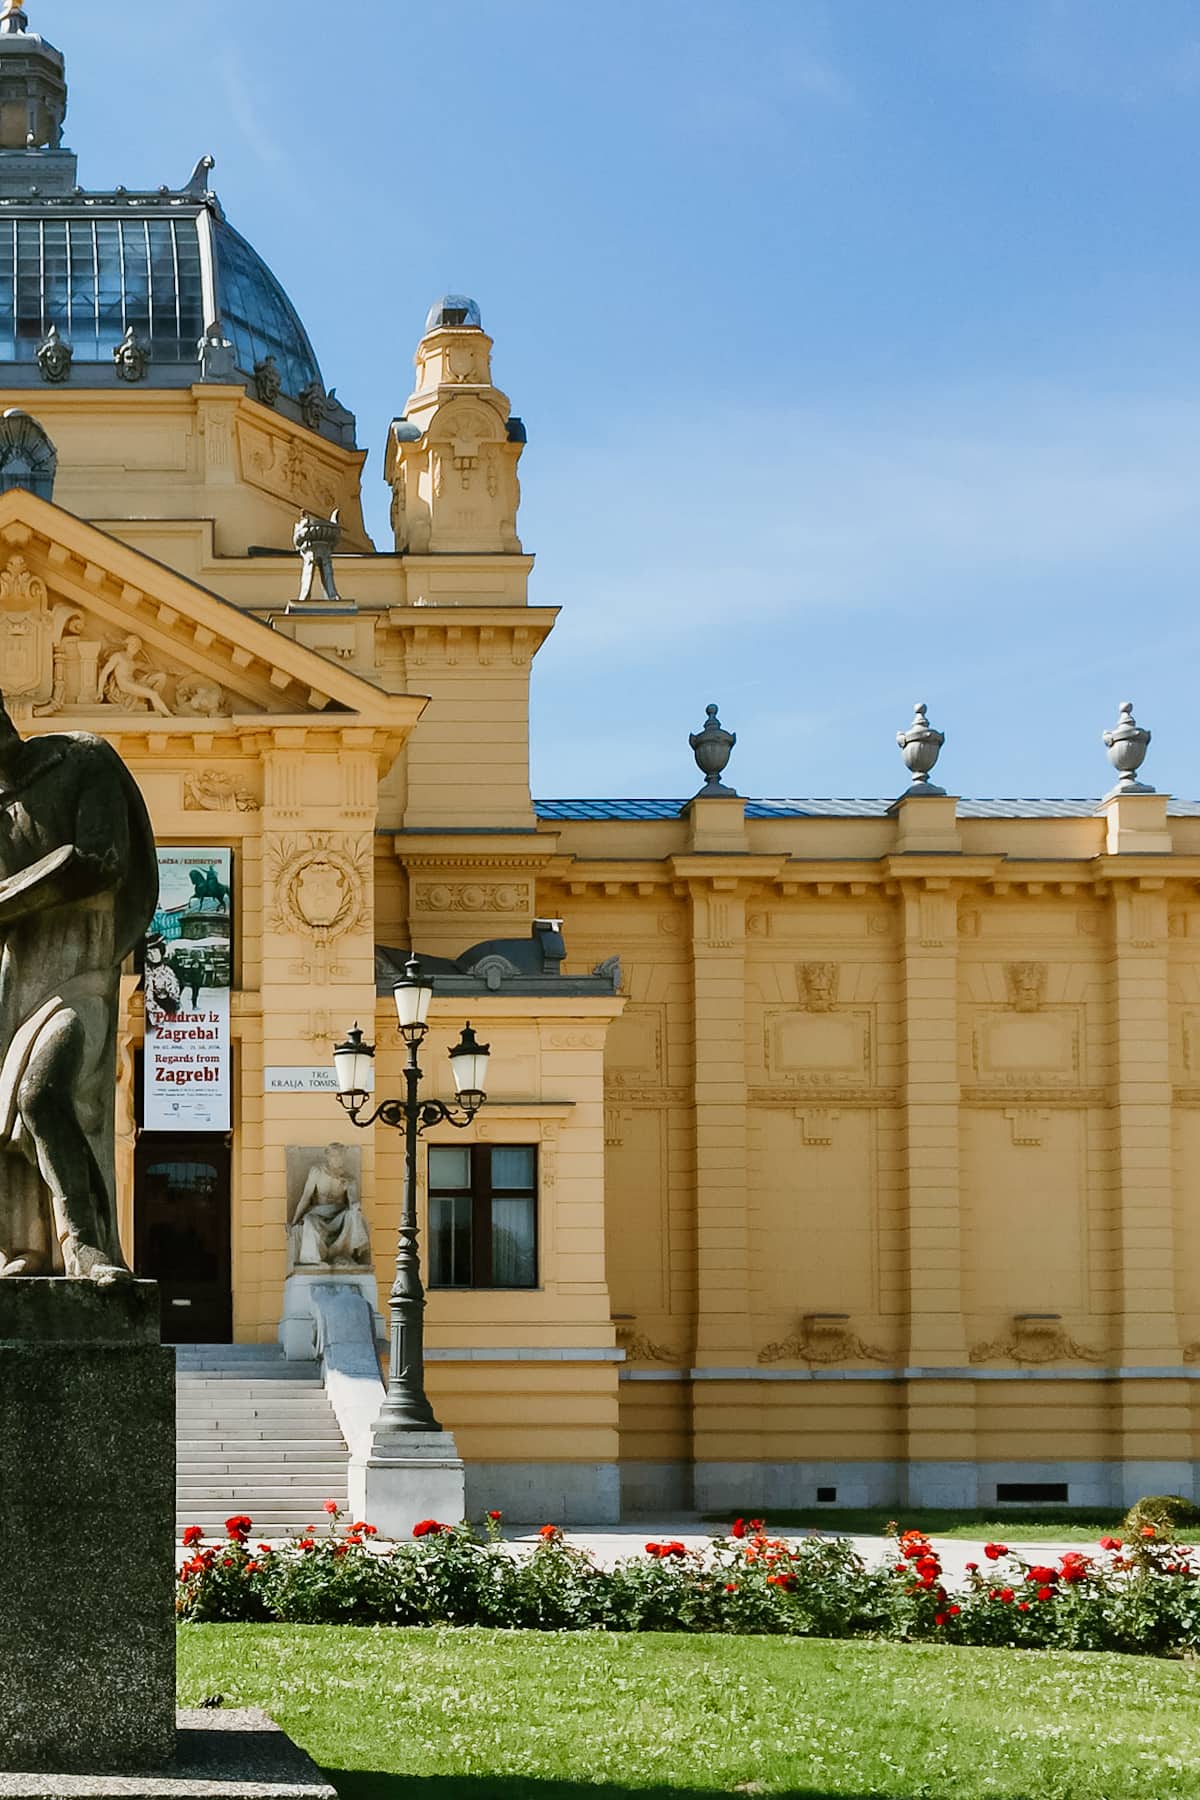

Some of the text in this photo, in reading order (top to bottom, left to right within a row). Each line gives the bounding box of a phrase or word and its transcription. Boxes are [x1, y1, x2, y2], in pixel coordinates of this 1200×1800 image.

[155, 1010, 220, 1023] Pozdrav iz
[155, 1026, 219, 1043] Zagreba!
[155, 1054, 220, 1064] Regards from
[155, 1066, 219, 1085] Zagreb!
[311, 1071, 329, 1079] TRG
[271, 1079, 339, 1088] KRALJA TOMISL
